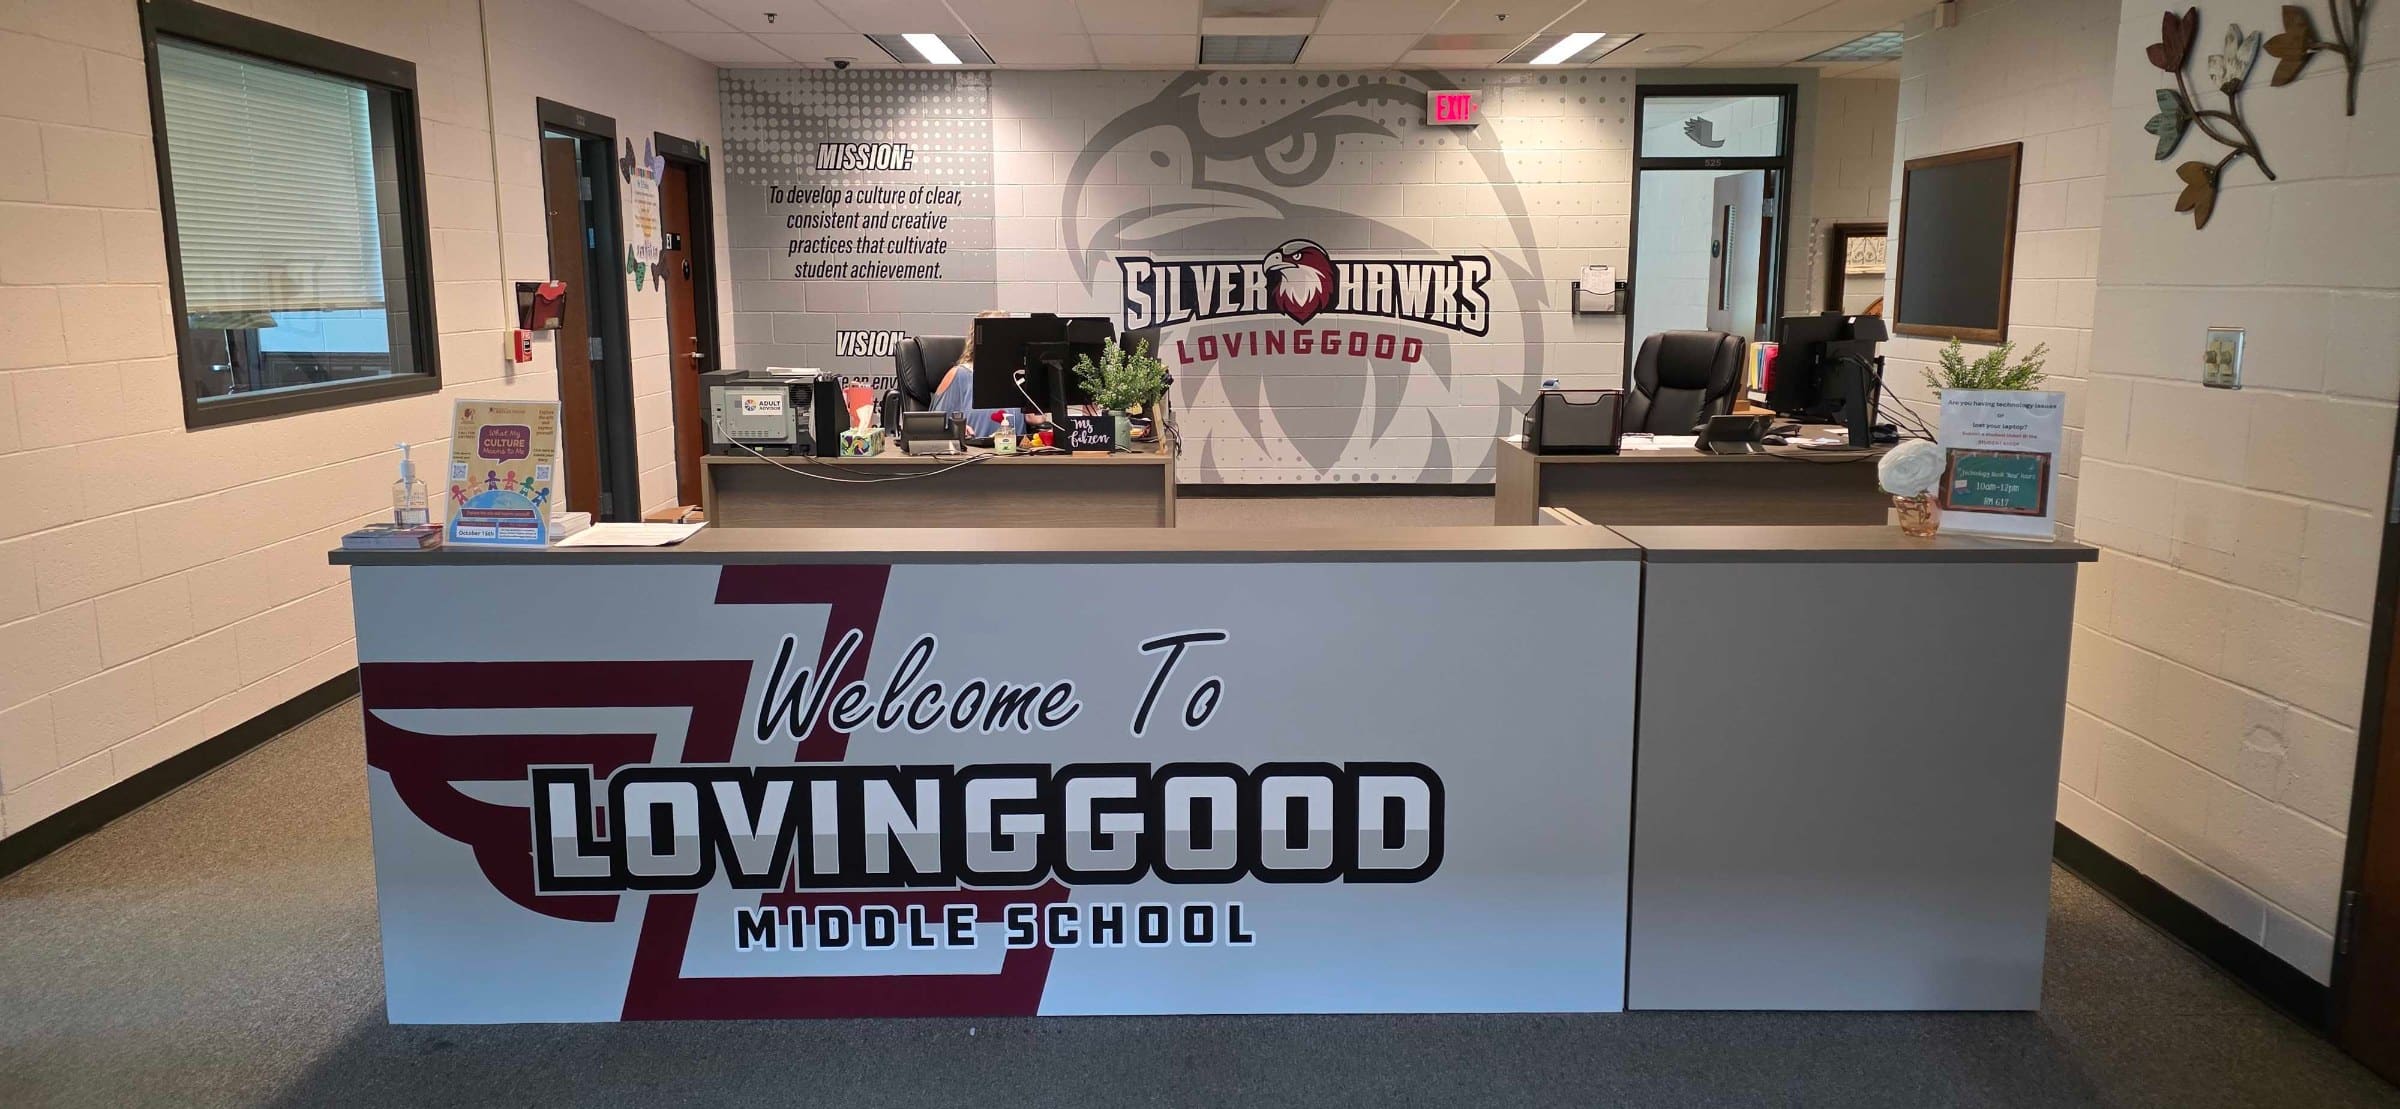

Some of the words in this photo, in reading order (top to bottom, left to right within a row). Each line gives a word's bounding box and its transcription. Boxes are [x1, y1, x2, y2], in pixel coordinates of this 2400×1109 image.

[1436, 94, 1472, 121] EXIT
[815, 143, 914, 170] MISSION:
[770, 185, 784, 204] To
[787, 185, 842, 208] develop
[845, 190, 853, 204] a
[856, 186, 905, 204] culture
[909, 186, 924, 204] of
[925, 186, 962, 206] clear,
[787, 211, 860, 229] consistent
[863, 211, 888, 229] and
[891, 211, 947, 229] creative
[788, 236, 853, 257] practices
[856, 236, 884, 254] that
[887, 236, 947, 254] cultivate
[794, 260, 848, 279] student
[850, 261, 943, 279] achievement.
[1118, 258, 1269, 330] SILVER
[1336, 256, 1490, 336] HAWKS
[836, 330, 905, 357] VISION
[1176, 329, 1425, 365] LOVINGGOOD
[1996, 401, 2033, 409] technology
[483, 439, 525, 447] CULTURE
[1977, 482, 2020, 493] 10am-12pm
[755, 629, 1082, 743] Welcome
[1130, 629, 1230, 738] To
[530, 763, 1444, 893] LOVINGGOOD
[735, 905, 979, 952] MIDDLE
[1003, 903, 1256, 950] SCHOOL
